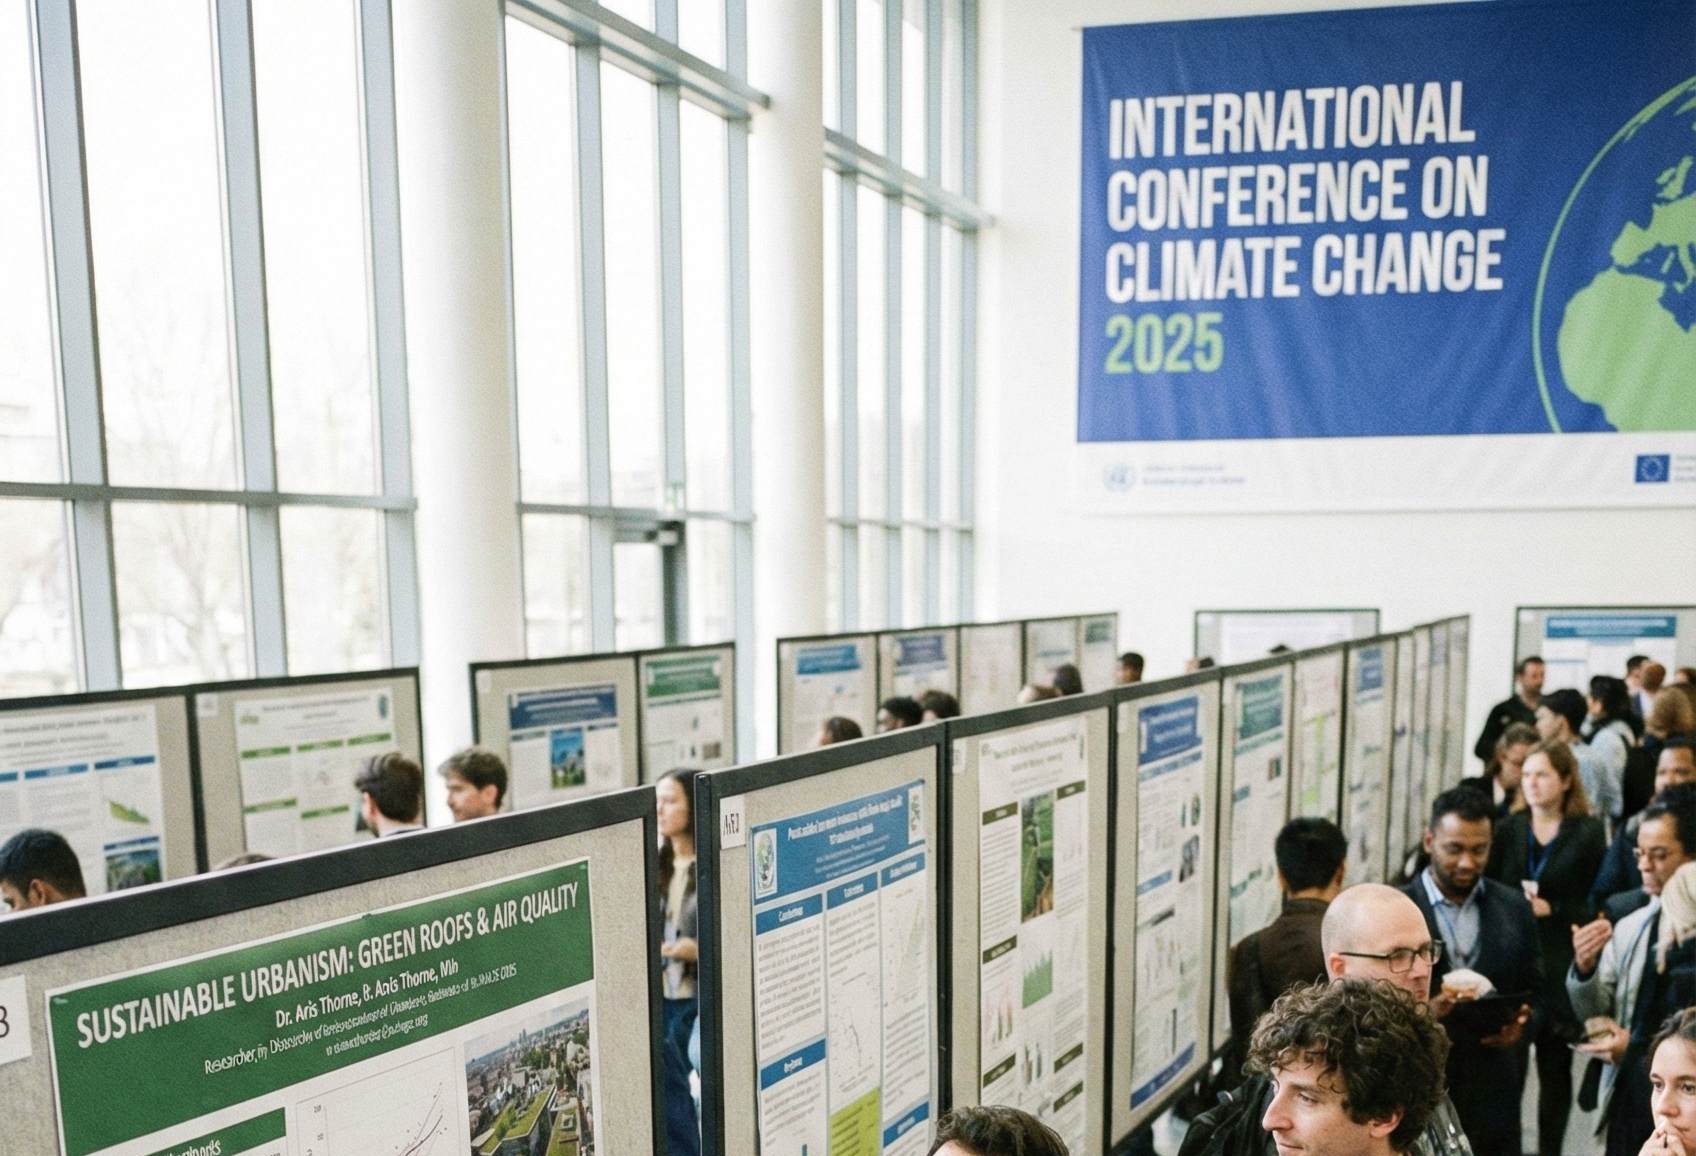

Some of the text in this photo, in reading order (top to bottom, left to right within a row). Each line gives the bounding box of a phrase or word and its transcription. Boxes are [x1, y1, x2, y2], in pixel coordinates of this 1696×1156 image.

[1107, 80, 1477, 161] INTERNATIONAL
[1106, 154, 1490, 233] CONFERENCE ON
[1104, 228, 1506, 305] CLIMATE CHANGE
[1103, 312, 1225, 375] 2025
[76, 974, 237, 1049] SUSTAINABLE
[240, 945, 355, 1003] URBANISM:
[358, 926, 417, 970] GREEN
[420, 911, 473, 954] ROOFS
[476, 906, 491, 935] &
[492, 899, 518, 932] AIR
[520, 881, 579, 924] QUALITY
[275, 1009, 293, 1029] Dr.
